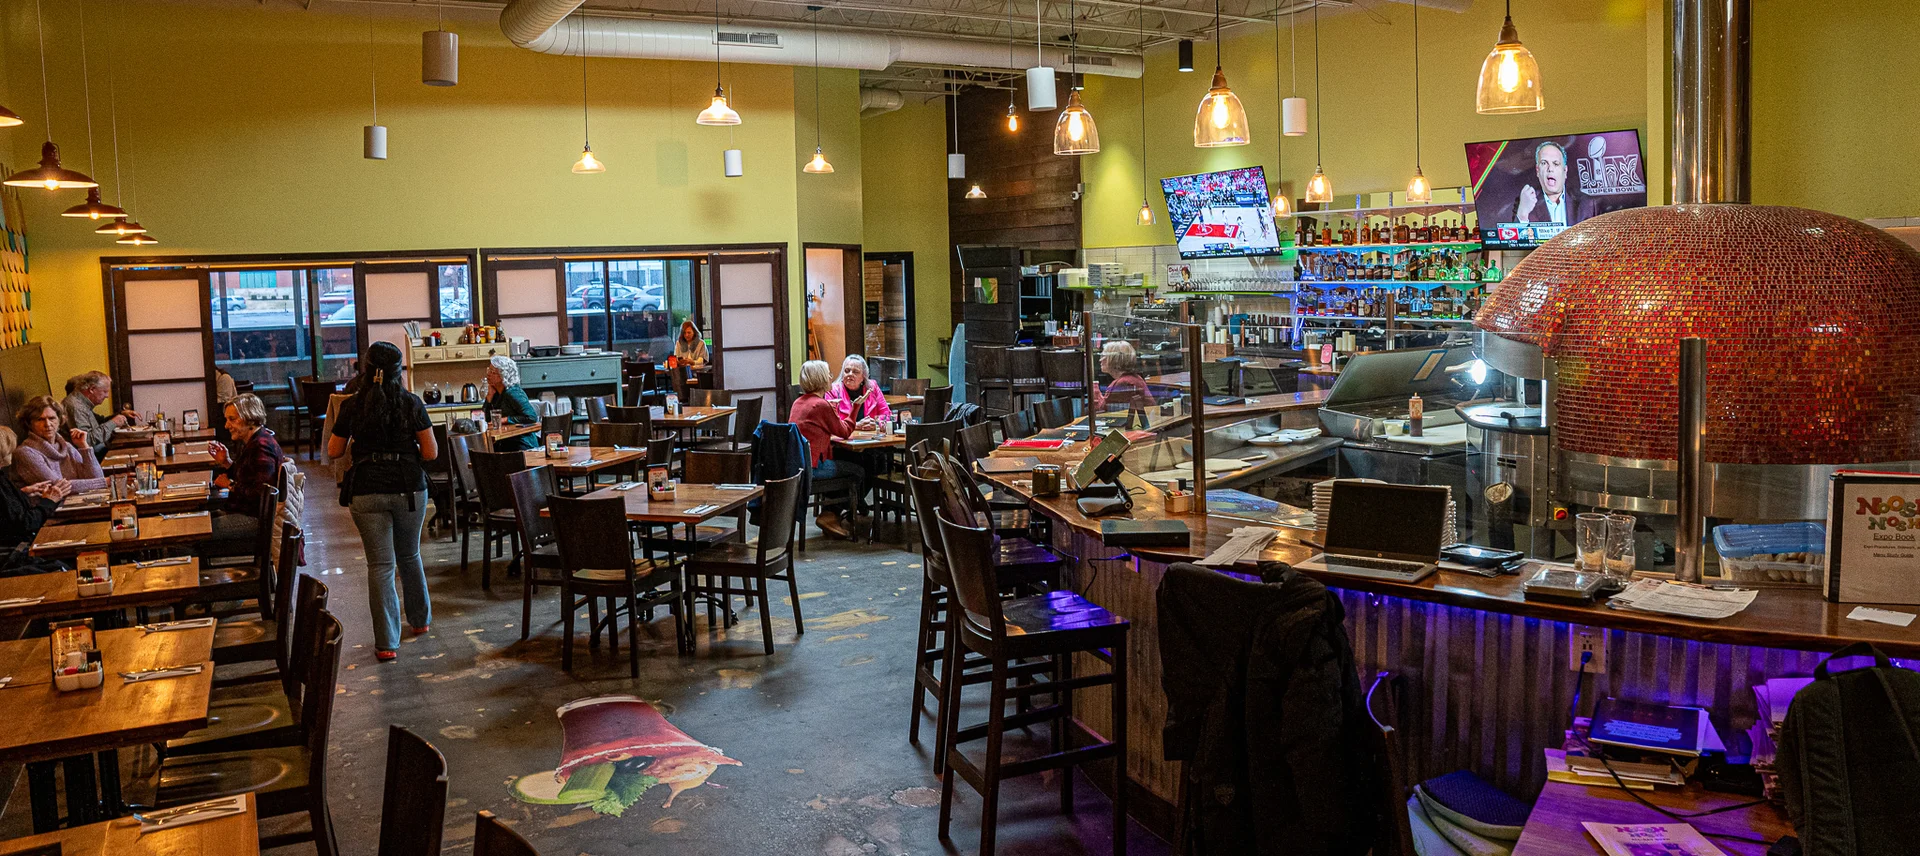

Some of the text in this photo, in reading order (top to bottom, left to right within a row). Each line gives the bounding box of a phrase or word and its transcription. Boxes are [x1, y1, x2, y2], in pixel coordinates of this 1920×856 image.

[1856, 495, 1920, 517] NOOS
[1873, 533, 1915, 541] Expo Book
